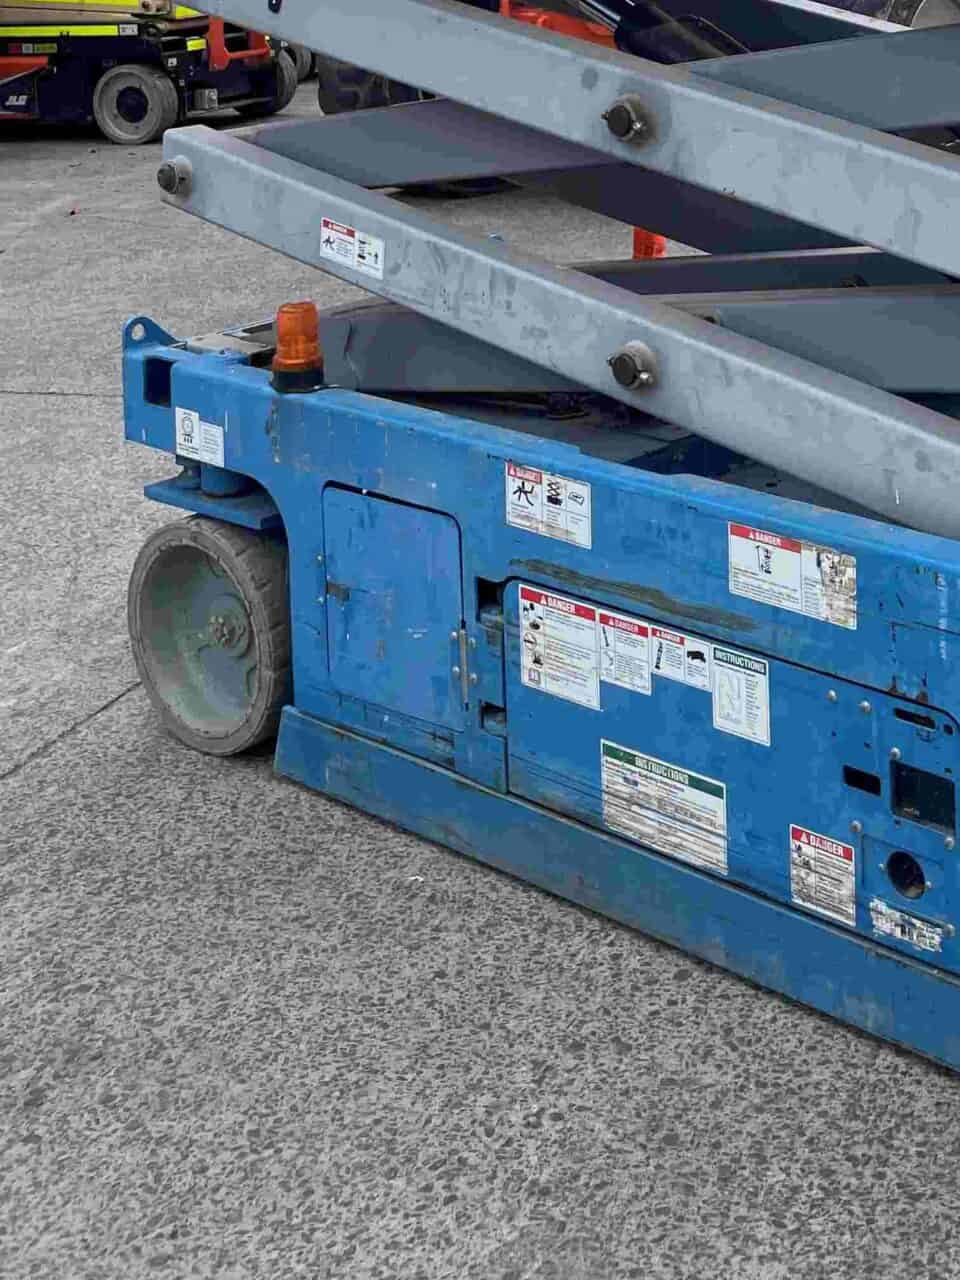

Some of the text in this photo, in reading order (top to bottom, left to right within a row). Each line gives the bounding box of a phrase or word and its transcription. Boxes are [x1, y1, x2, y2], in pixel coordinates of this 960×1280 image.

[547, 596, 576, 615] DANGER
[614, 617, 639, 633] DANGER
[715, 650, 765, 673] INSTRUCTIONS
[810, 834, 843, 857] DANGER
